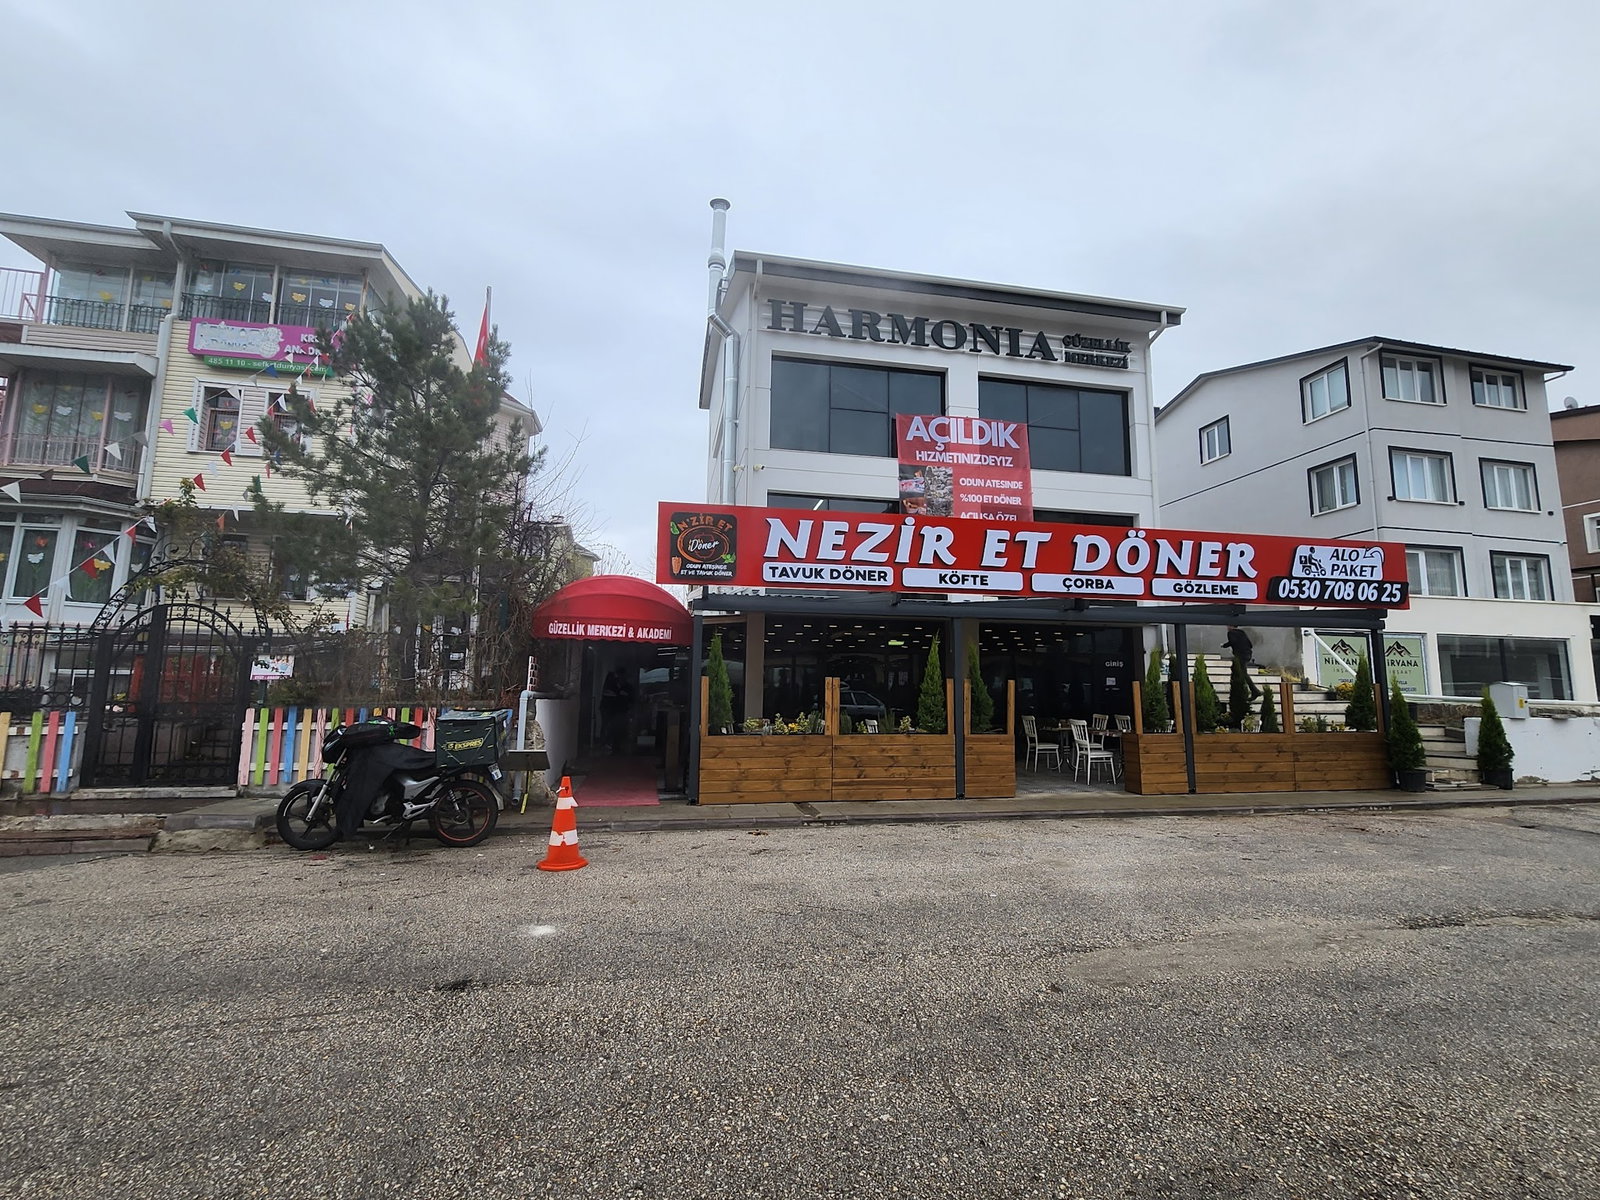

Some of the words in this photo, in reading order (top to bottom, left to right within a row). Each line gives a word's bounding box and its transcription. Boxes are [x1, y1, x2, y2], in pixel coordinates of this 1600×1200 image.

[767, 299, 1058, 362] HARMONIA
[208, 357, 223, 365] 485
[237, 358, 246, 366] 10
[1064, 352, 1129, 369] MERKEZİ
[906, 416, 1020, 451] AÇILDIK
[916, 450, 1014, 467] HIZMETINIZDEYIZ
[959, 477, 985, 487] ODUN
[959, 493, 983, 504] %100
[983, 494, 993, 504] ET
[994, 494, 1022, 505] DÖNER
[717, 519, 733, 532] ET
[690, 538, 720, 552] Döner
[763, 516, 957, 566] NEZİR
[981, 529, 1053, 570] ET
[1073, 529, 1258, 579] DÖNER
[1329, 548, 1360, 562] ALO
[769, 566, 825, 580] TAVUK
[829, 566, 888, 583] DÖNER
[938, 570, 989, 586] KÖFTE
[1330, 563, 1377, 578] PAKET
[1062, 577, 1115, 592] ÇORBA
[1172, 580, 1239, 596] GÖZLEME
[1278, 578, 1321, 600] 0530
[1323, 580, 1355, 601] 708
[1357, 582, 1379, 602] 06
[1381, 583, 1402, 603] 25
[548, 620, 585, 636] GÜZELLİK
[587, 623, 626, 638] MERKEZİ
[627, 627, 635, 638] &
[636, 626, 672, 640] AKADEMİ
